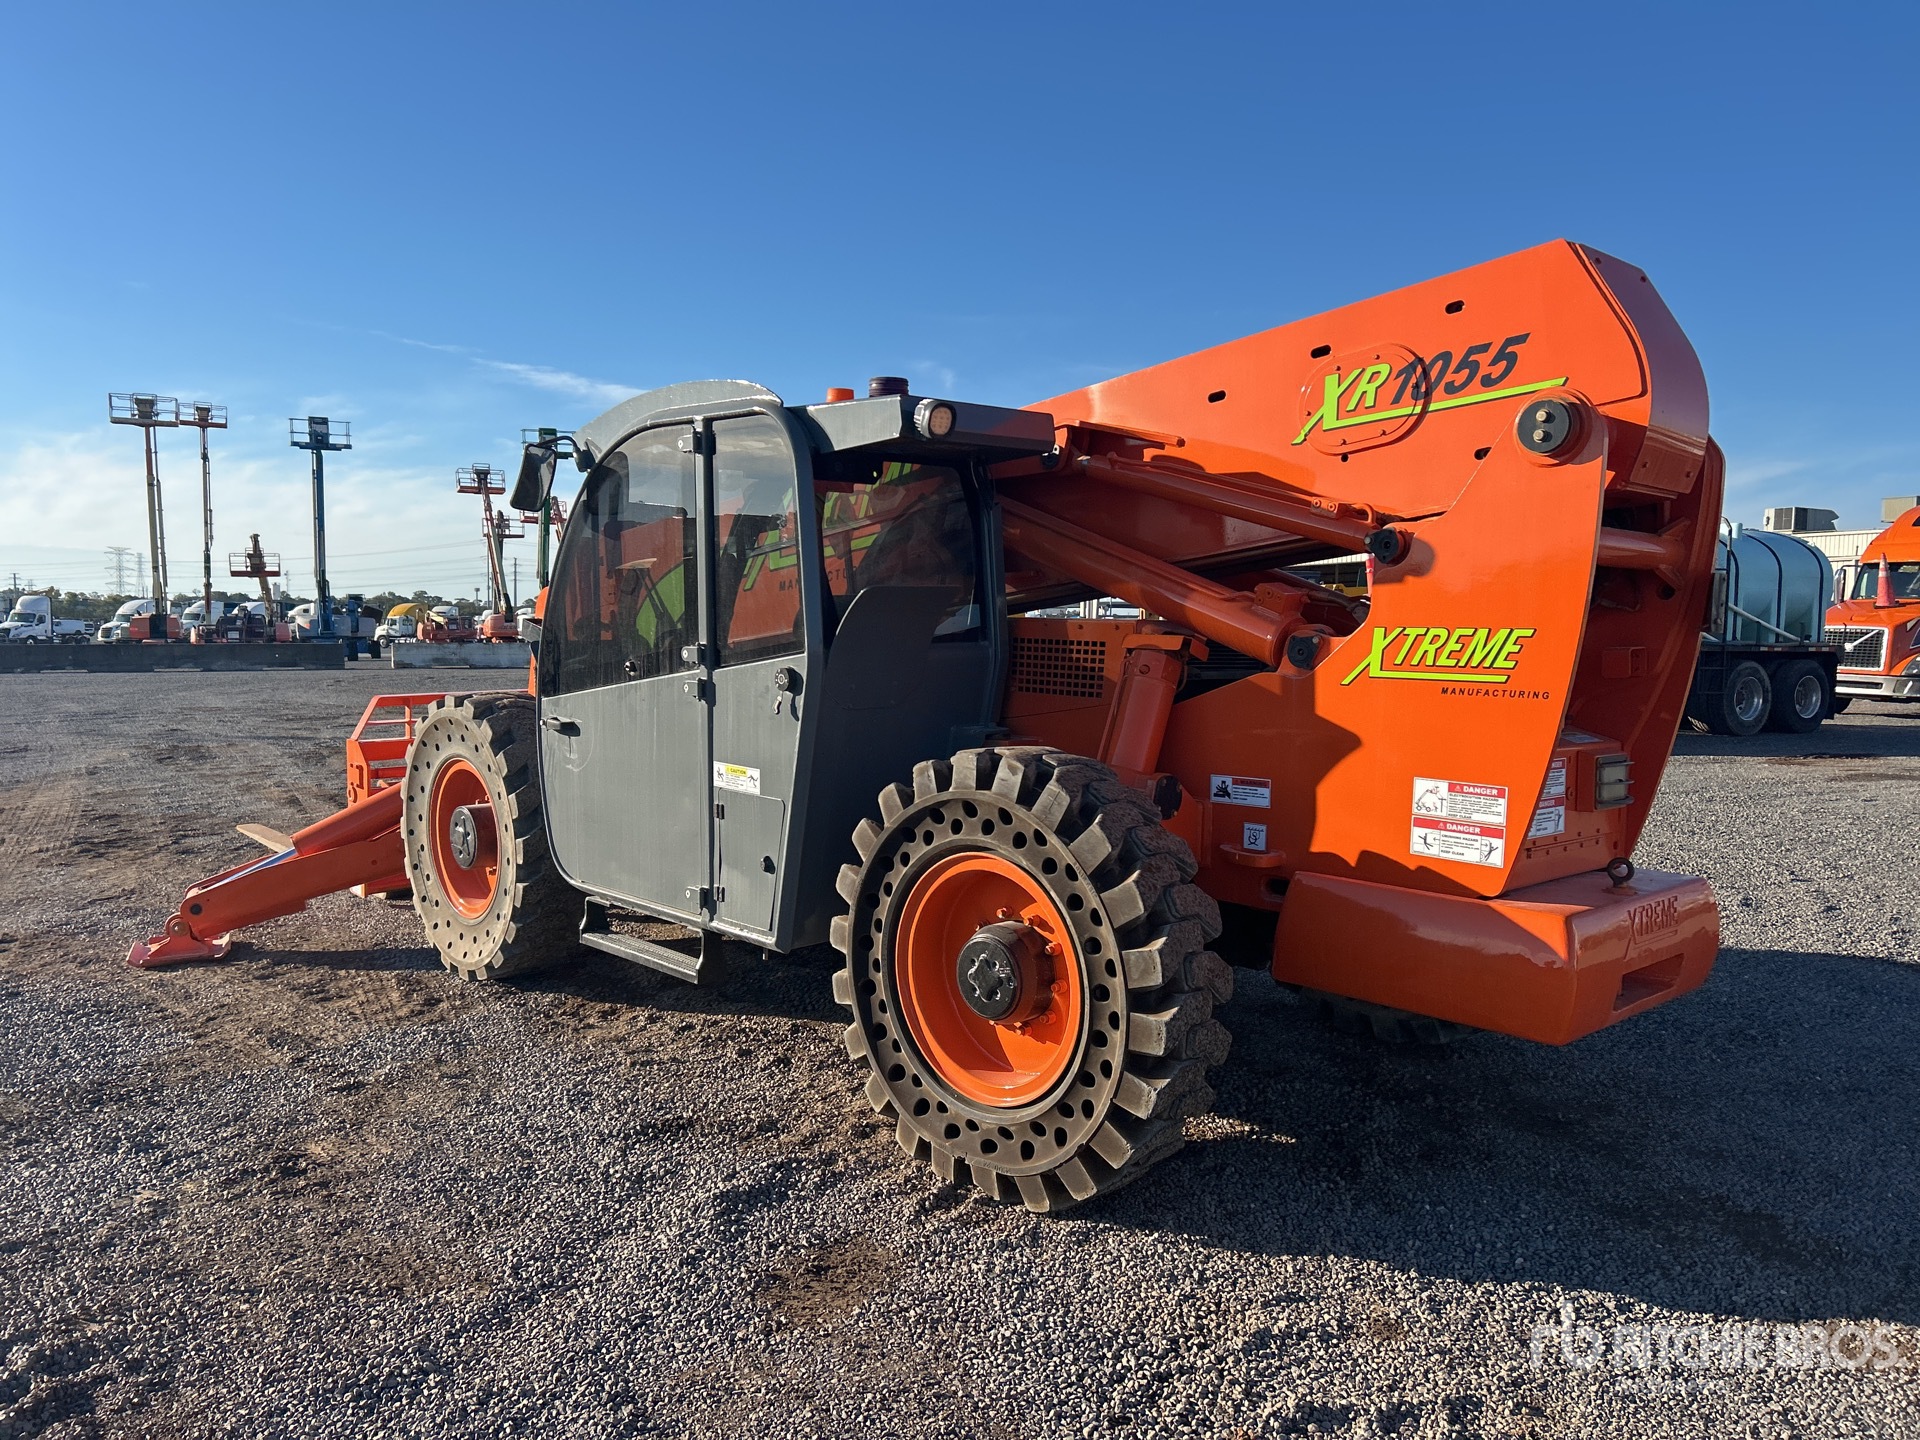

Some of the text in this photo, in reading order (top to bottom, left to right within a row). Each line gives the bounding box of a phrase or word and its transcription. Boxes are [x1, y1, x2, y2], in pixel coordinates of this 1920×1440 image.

[1340, 626, 1537, 686] XTREME
[1440, 686, 1551, 701] MANUFACTURING
[1463, 785, 1499, 797] DANGER
[1446, 823, 1481, 835] DANGER
[1623, 895, 1679, 961] XTREME
